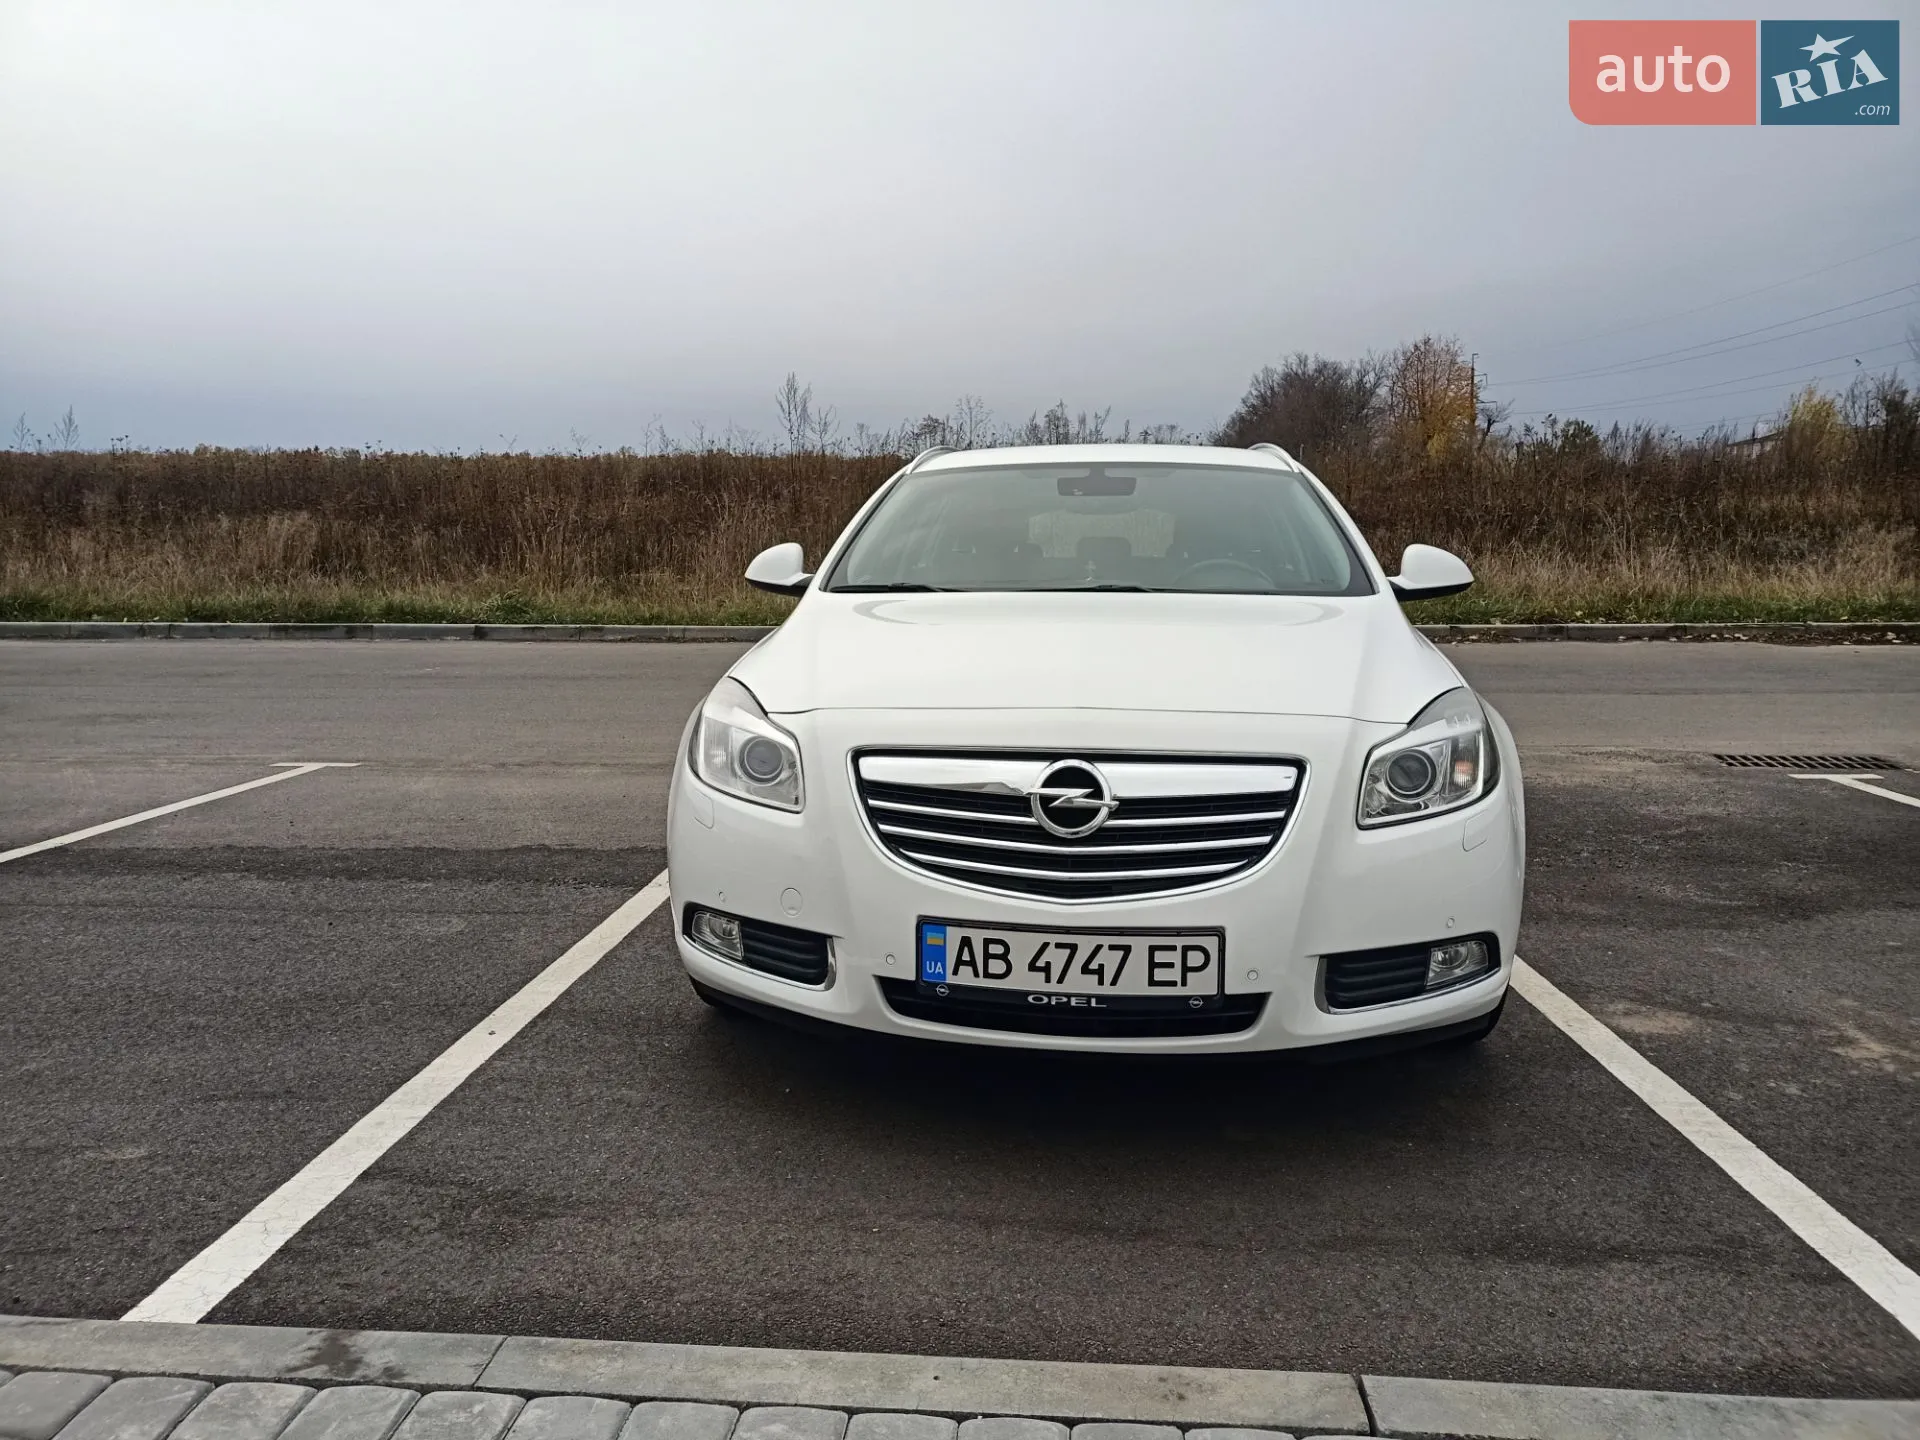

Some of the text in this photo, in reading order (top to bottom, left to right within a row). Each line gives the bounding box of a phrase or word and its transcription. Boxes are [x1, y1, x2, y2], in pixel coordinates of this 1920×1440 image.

[926, 961, 944, 975] UA
[952, 936, 1211, 987] AB 4747 EP
[1027, 994, 1107, 1008] OPEL
